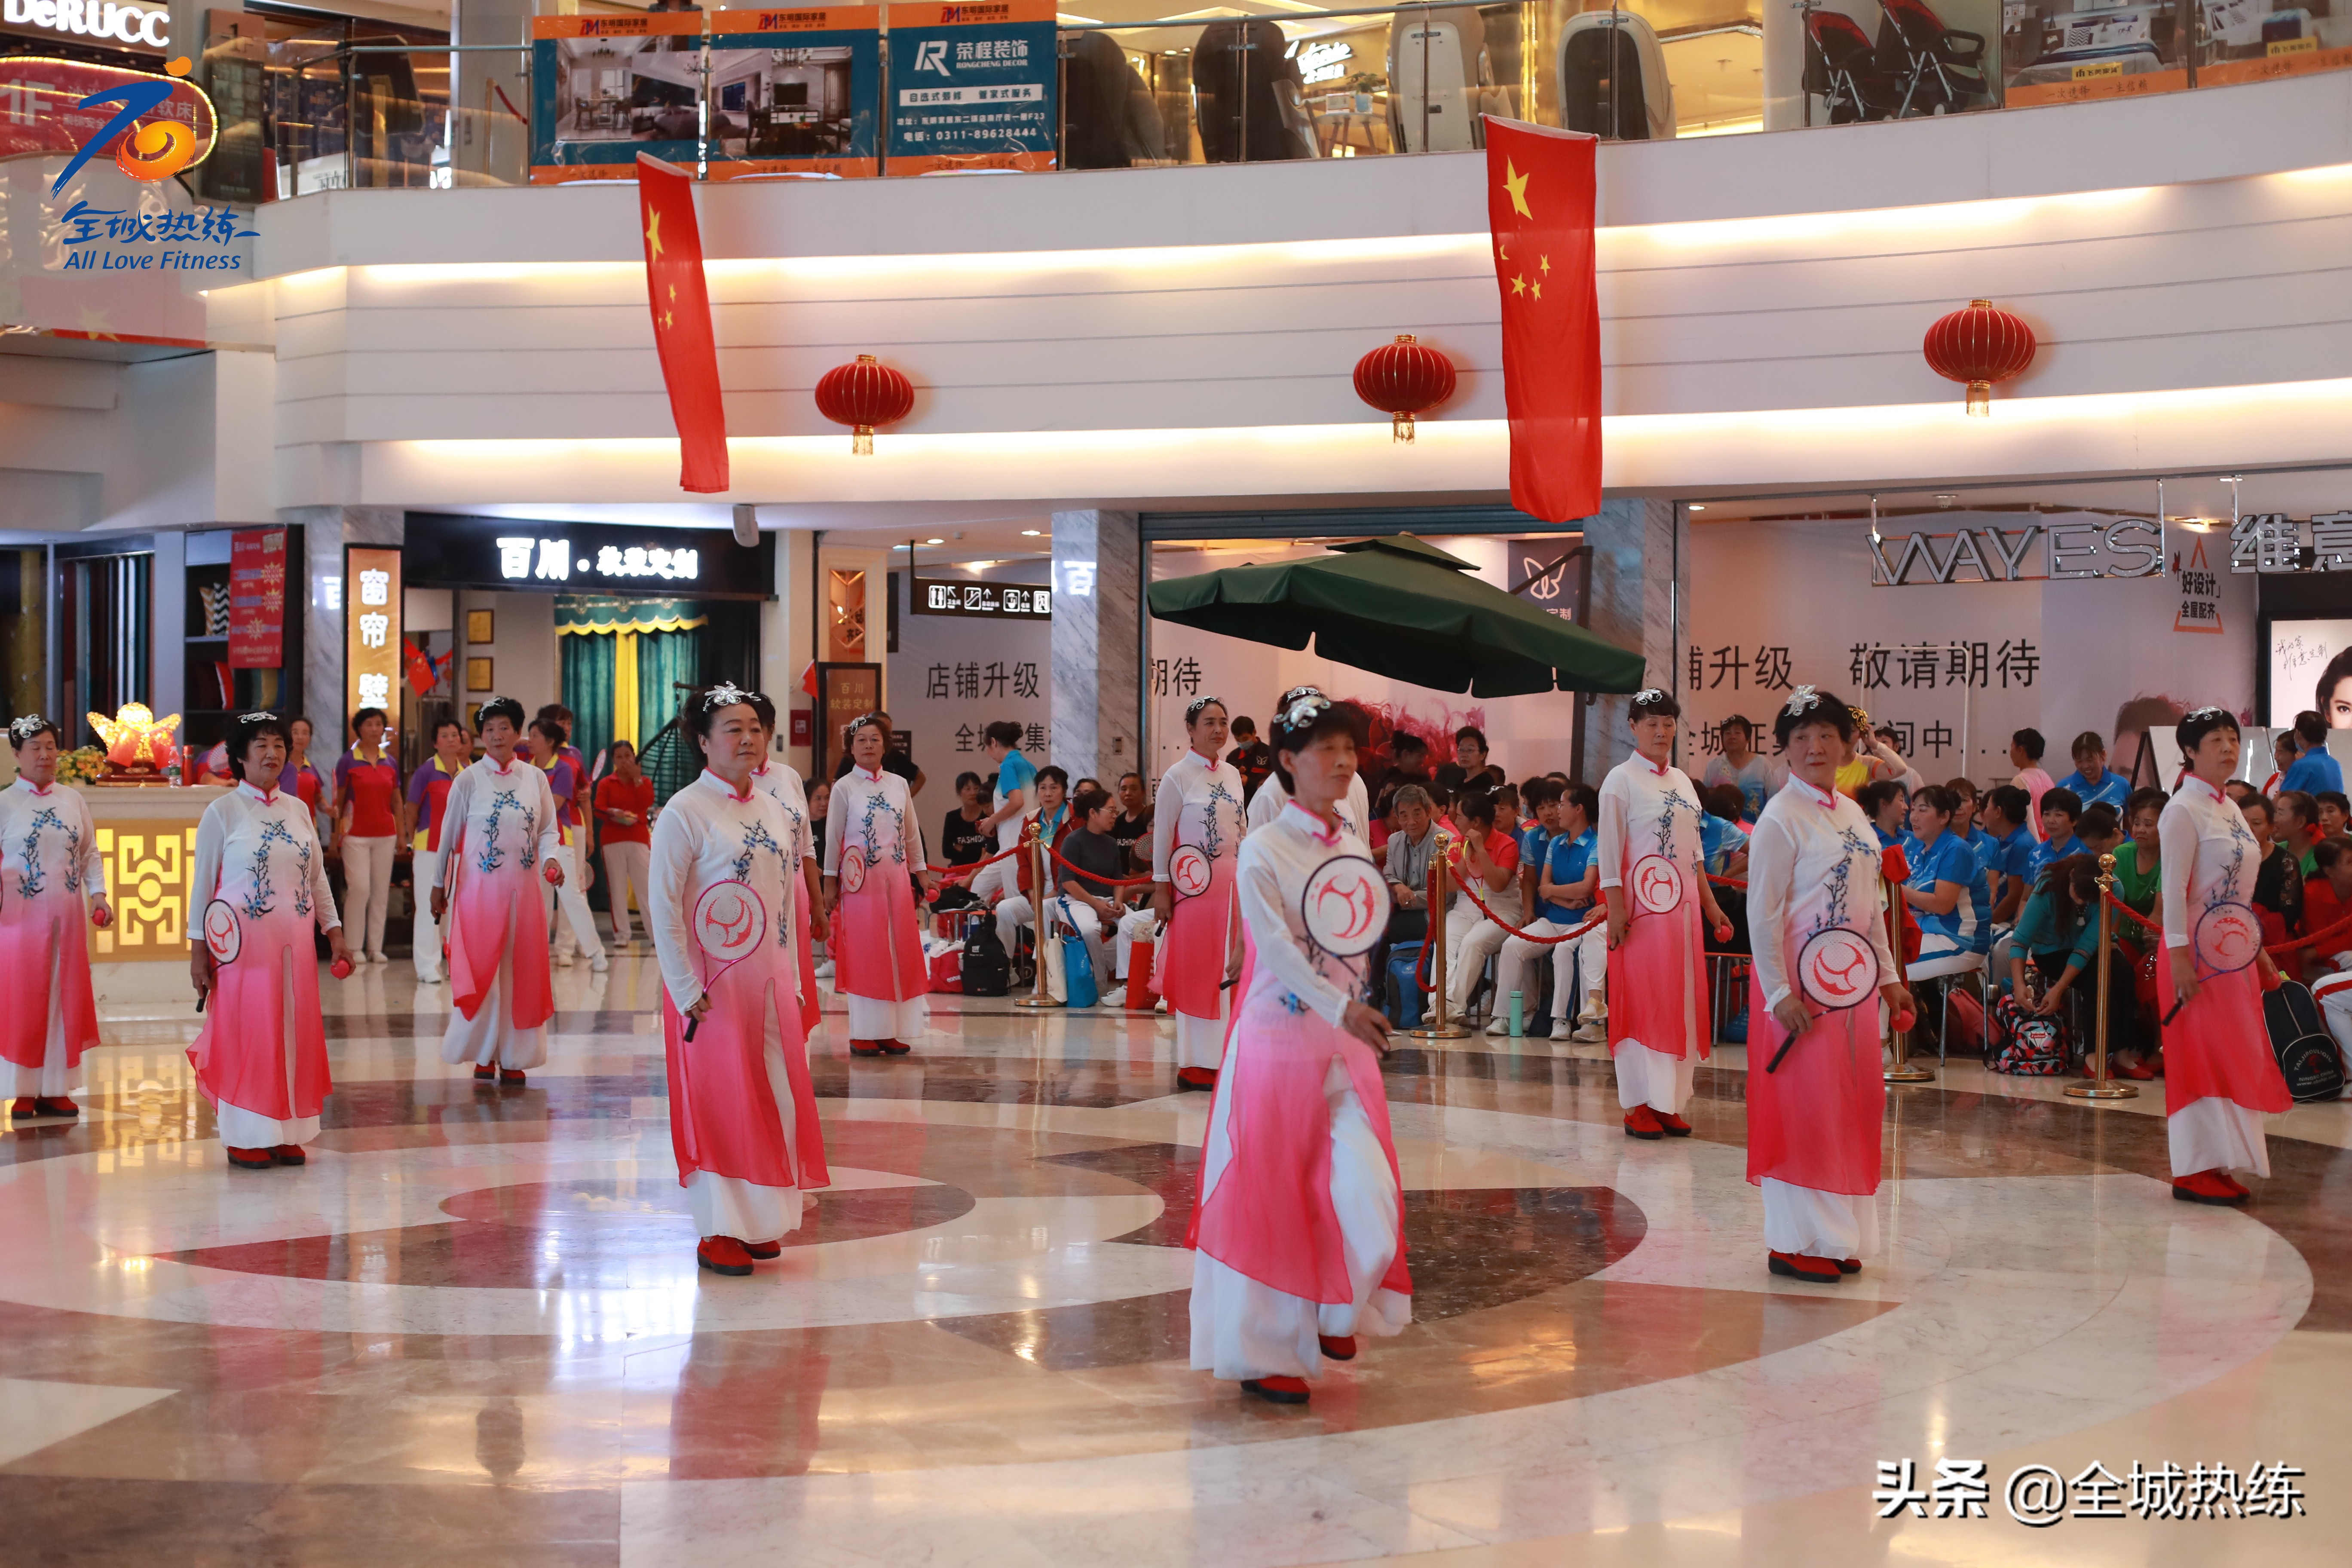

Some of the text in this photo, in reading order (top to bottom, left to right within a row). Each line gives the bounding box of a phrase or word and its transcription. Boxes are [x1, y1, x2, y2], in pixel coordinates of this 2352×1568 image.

[779, 12, 826, 21] 东明国际家居
[962, 4, 1008, 14] 东明国际家居
[601, 18, 647, 27] 东明国际家居
[956, 39, 1028, 60] 荣程装饰
[2046, 78, 2148, 98] 一次选择 一生信赖
[1865, 519, 2163, 585] WAYES
[2230, 511, 2352, 574] 维意
[360, 568, 389, 649] 窗帘
[2181, 600, 2216, 619] 全屋配齐
[1849, 639, 2040, 689] 敬请期待
[841, 683, 863, 694] 百川
[926, 661, 1039, 699] 店铺升级
[830, 698, 874, 709] 软装定制
